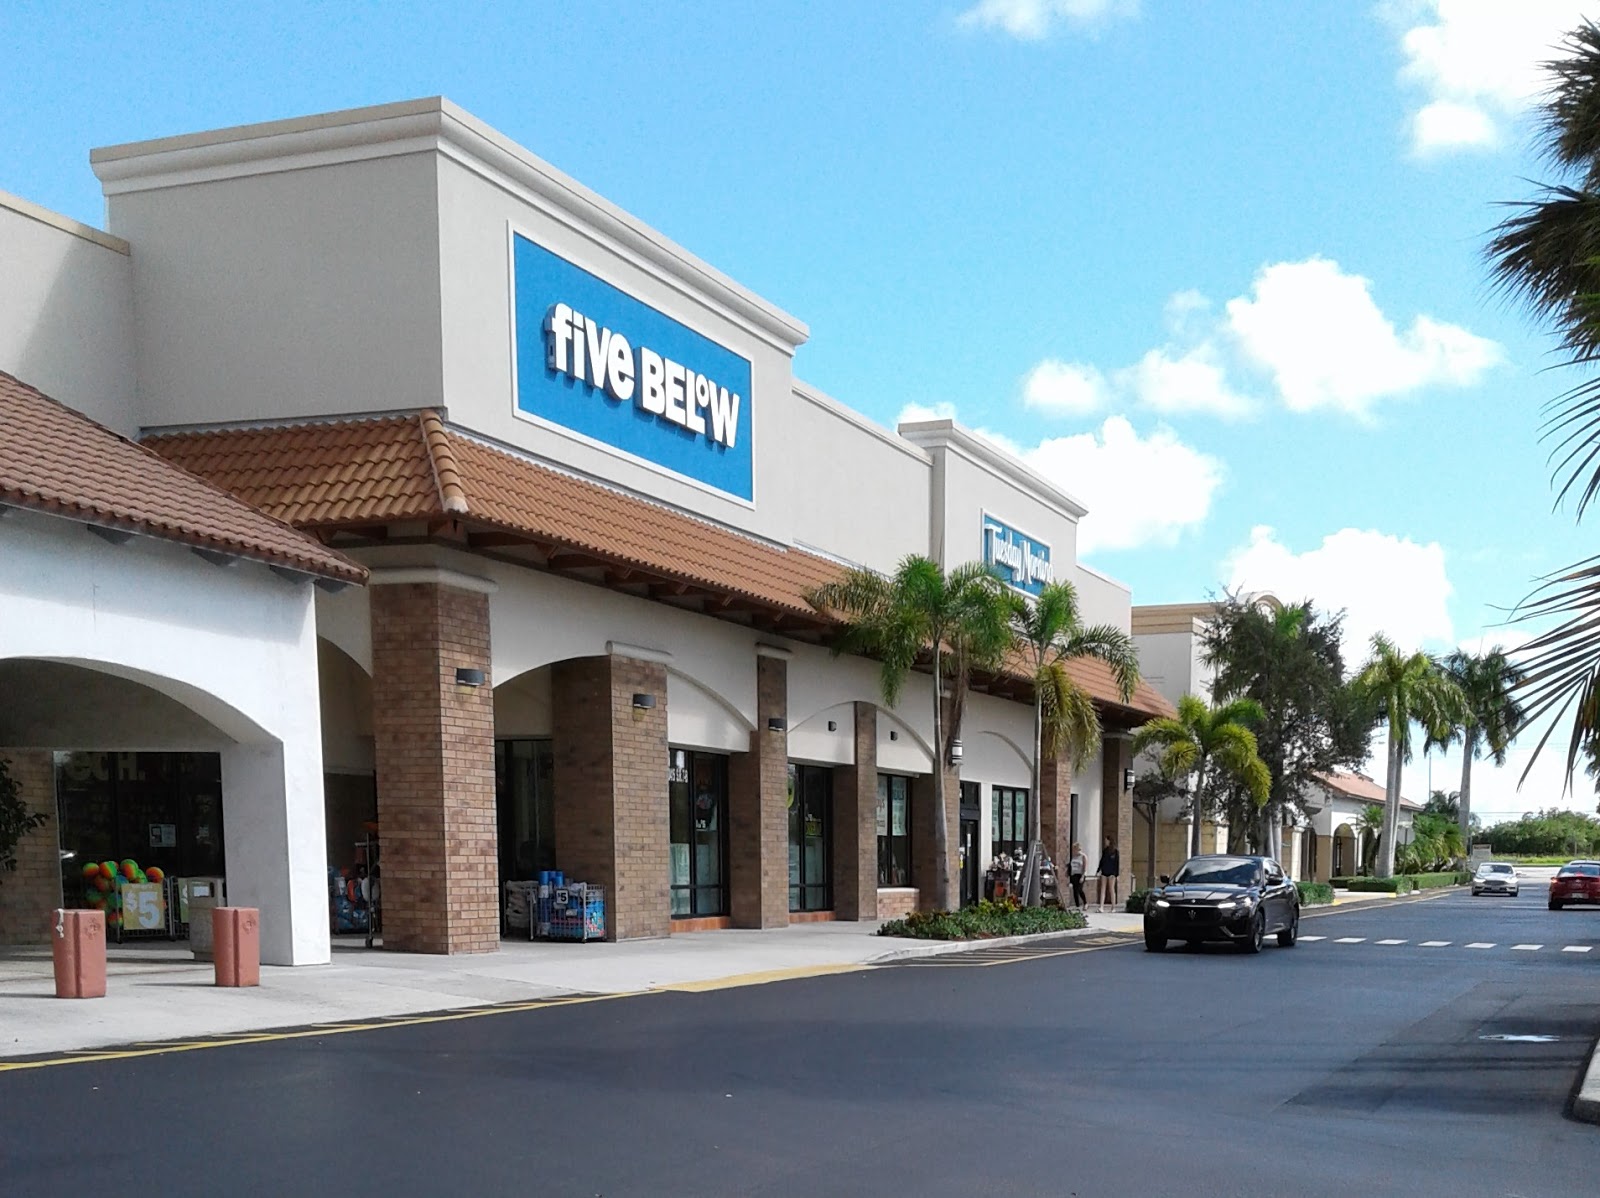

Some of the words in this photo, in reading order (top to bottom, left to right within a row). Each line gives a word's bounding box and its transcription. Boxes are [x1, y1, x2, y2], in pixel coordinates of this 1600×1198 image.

[548, 302, 635, 401] five
[985, 523, 1022, 582] Tuesday
[126, 891, 160, 929] $5
[557, 892, 567, 902] $5
